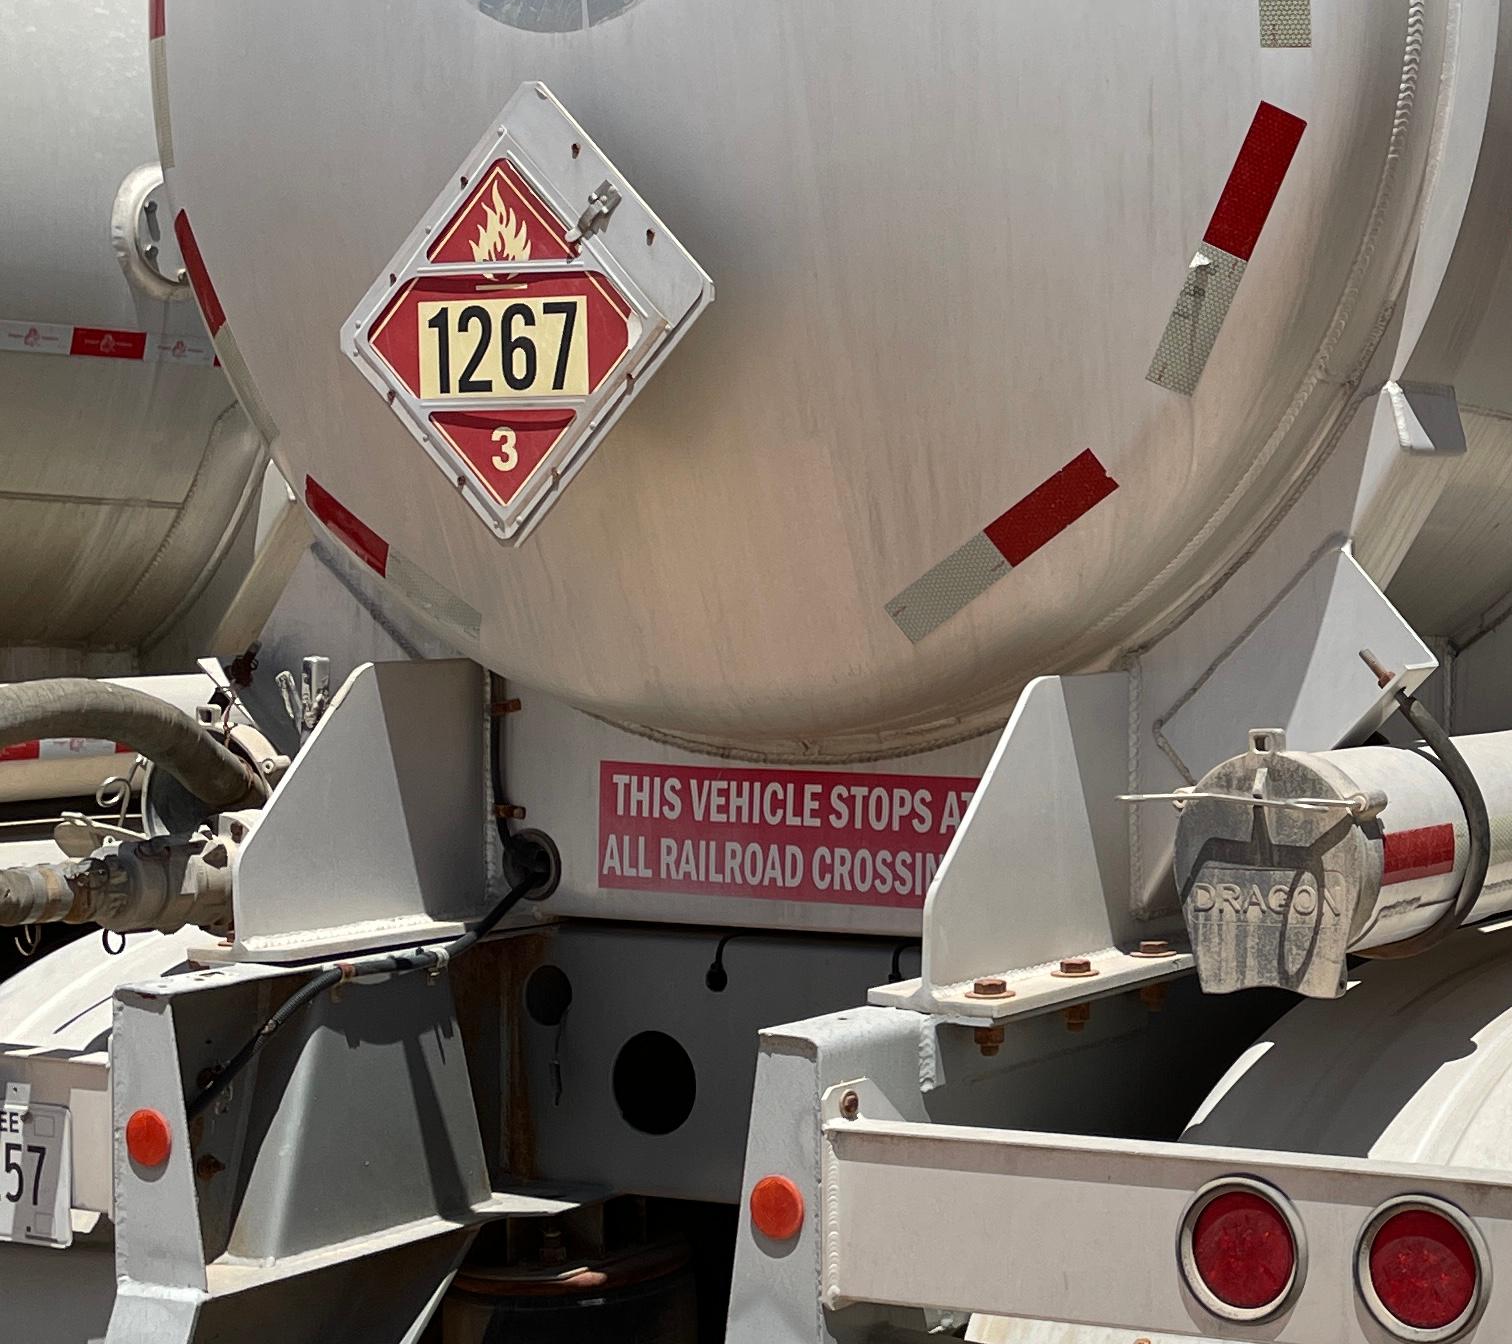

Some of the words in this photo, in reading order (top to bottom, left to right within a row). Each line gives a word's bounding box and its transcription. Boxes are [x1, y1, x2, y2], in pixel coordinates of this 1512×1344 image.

[426, 300, 579, 396] 1267
[490, 426, 519, 472] 3
[612, 773, 682, 821] THIS
[689, 778, 822, 828] VEHICLE
[829, 784, 933, 834] STOPS
[602, 833, 653, 879] ALL
[659, 837, 802, 888] RAILROAD
